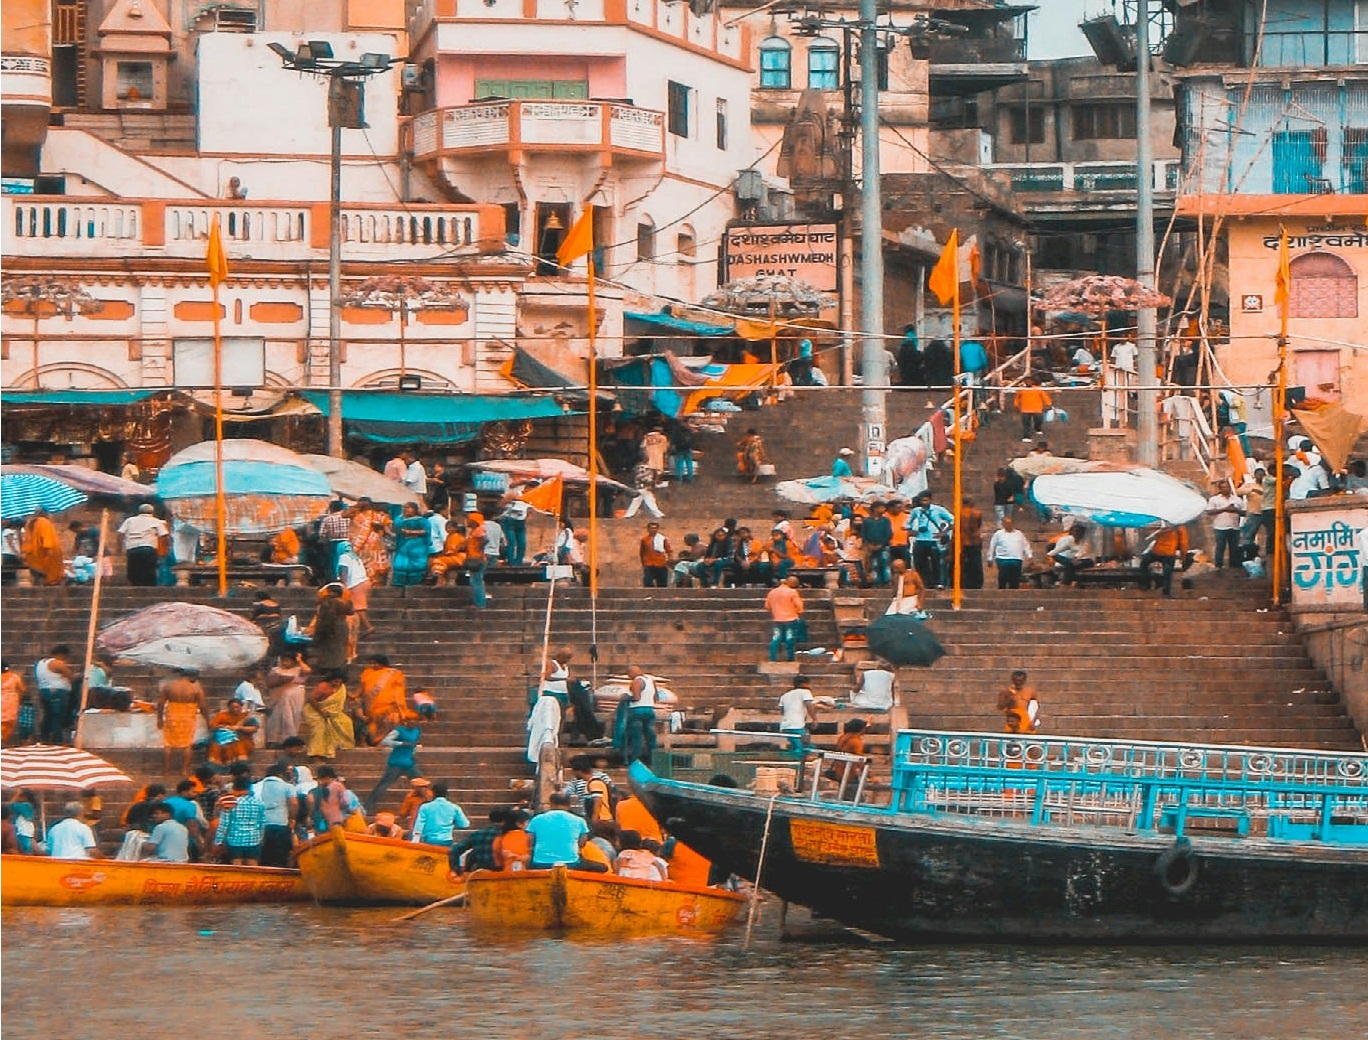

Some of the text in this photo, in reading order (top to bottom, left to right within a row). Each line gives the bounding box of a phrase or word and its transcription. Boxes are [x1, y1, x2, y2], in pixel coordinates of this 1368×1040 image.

[808, 232, 835, 244] घाट
[728, 252, 834, 265] DASHASHWMEDH
[1293, 520, 1355, 550] नमामि
[1293, 545, 1363, 593] गंग
